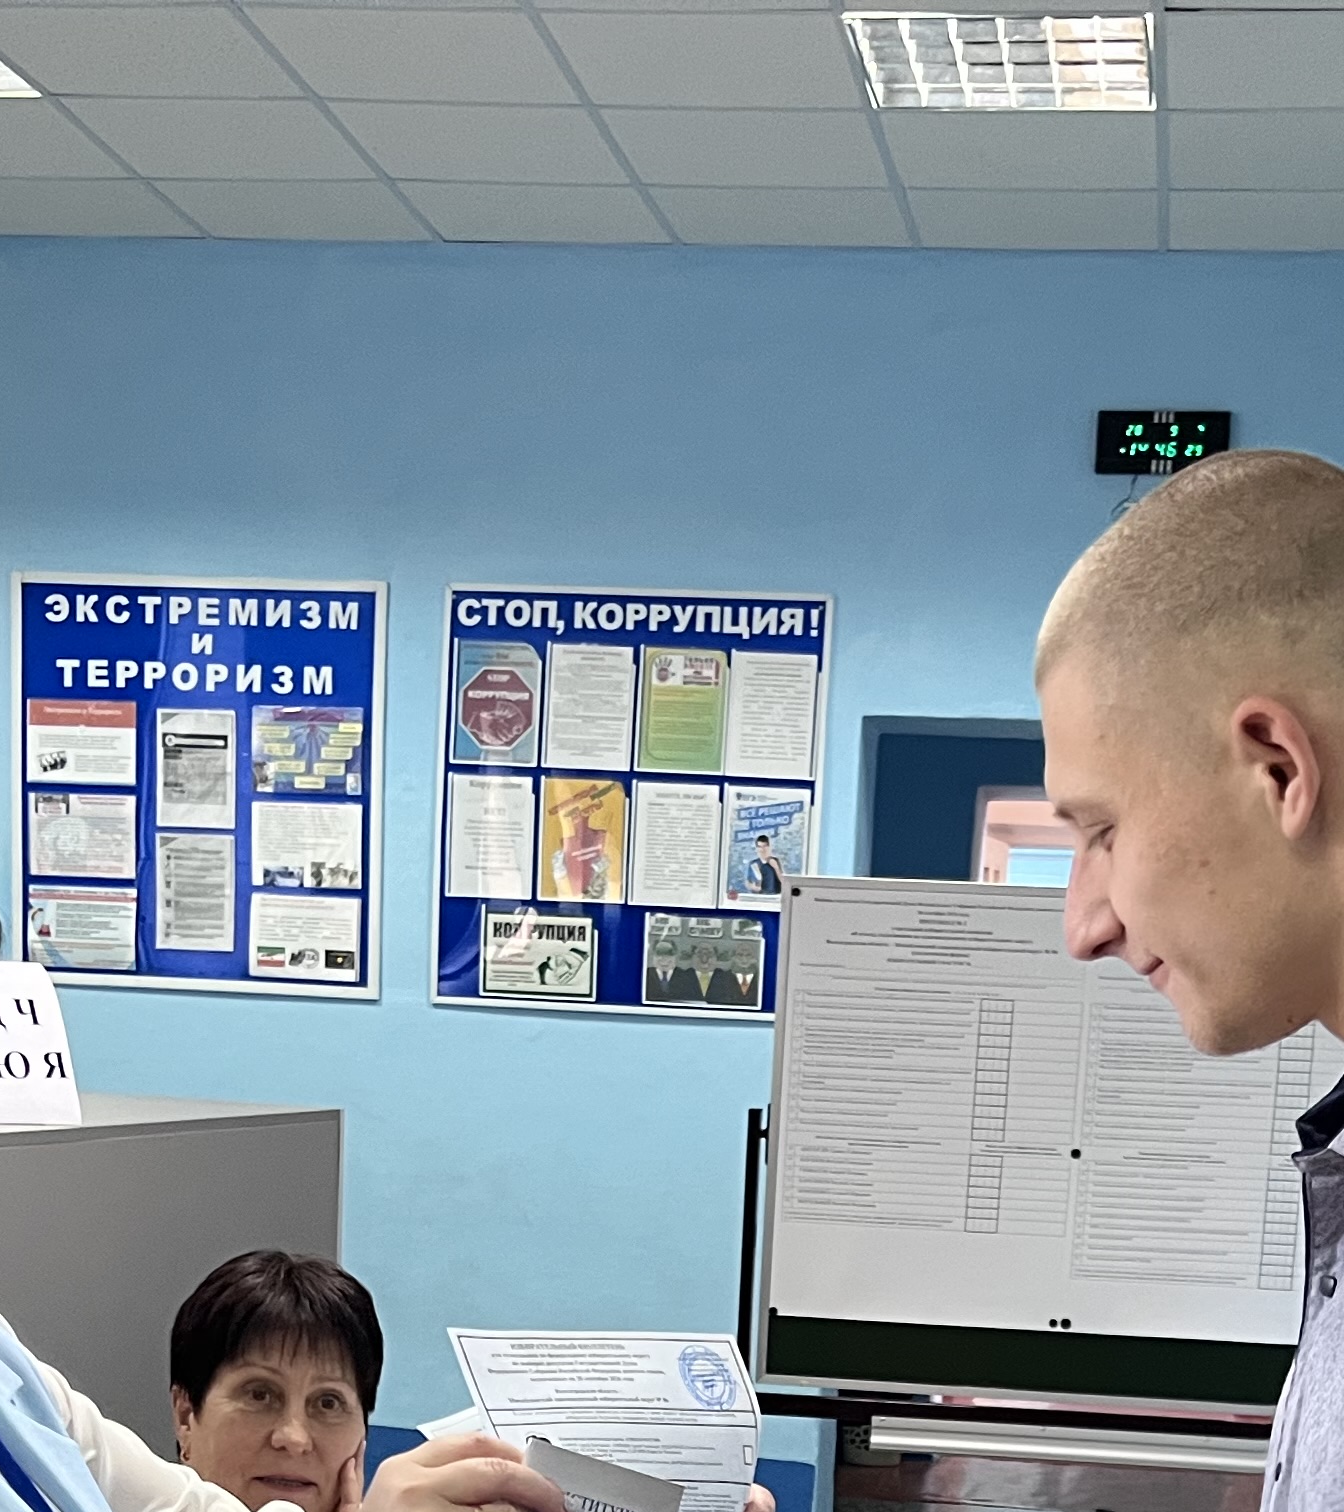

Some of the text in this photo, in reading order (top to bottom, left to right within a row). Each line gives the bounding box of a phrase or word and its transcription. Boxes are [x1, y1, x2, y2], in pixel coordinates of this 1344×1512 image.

[44, 593, 360, 631] ЭКСТРЕМИЗМ
[457, 598, 821, 640] СТОП, КОРРУПЦИЯ!
[191, 632, 214, 656] И
[56, 658, 334, 696] ТЕРРОРИЗМ
[12, 998, 43, 1026] Ч
[43, 1051, 69, 1079] Я
